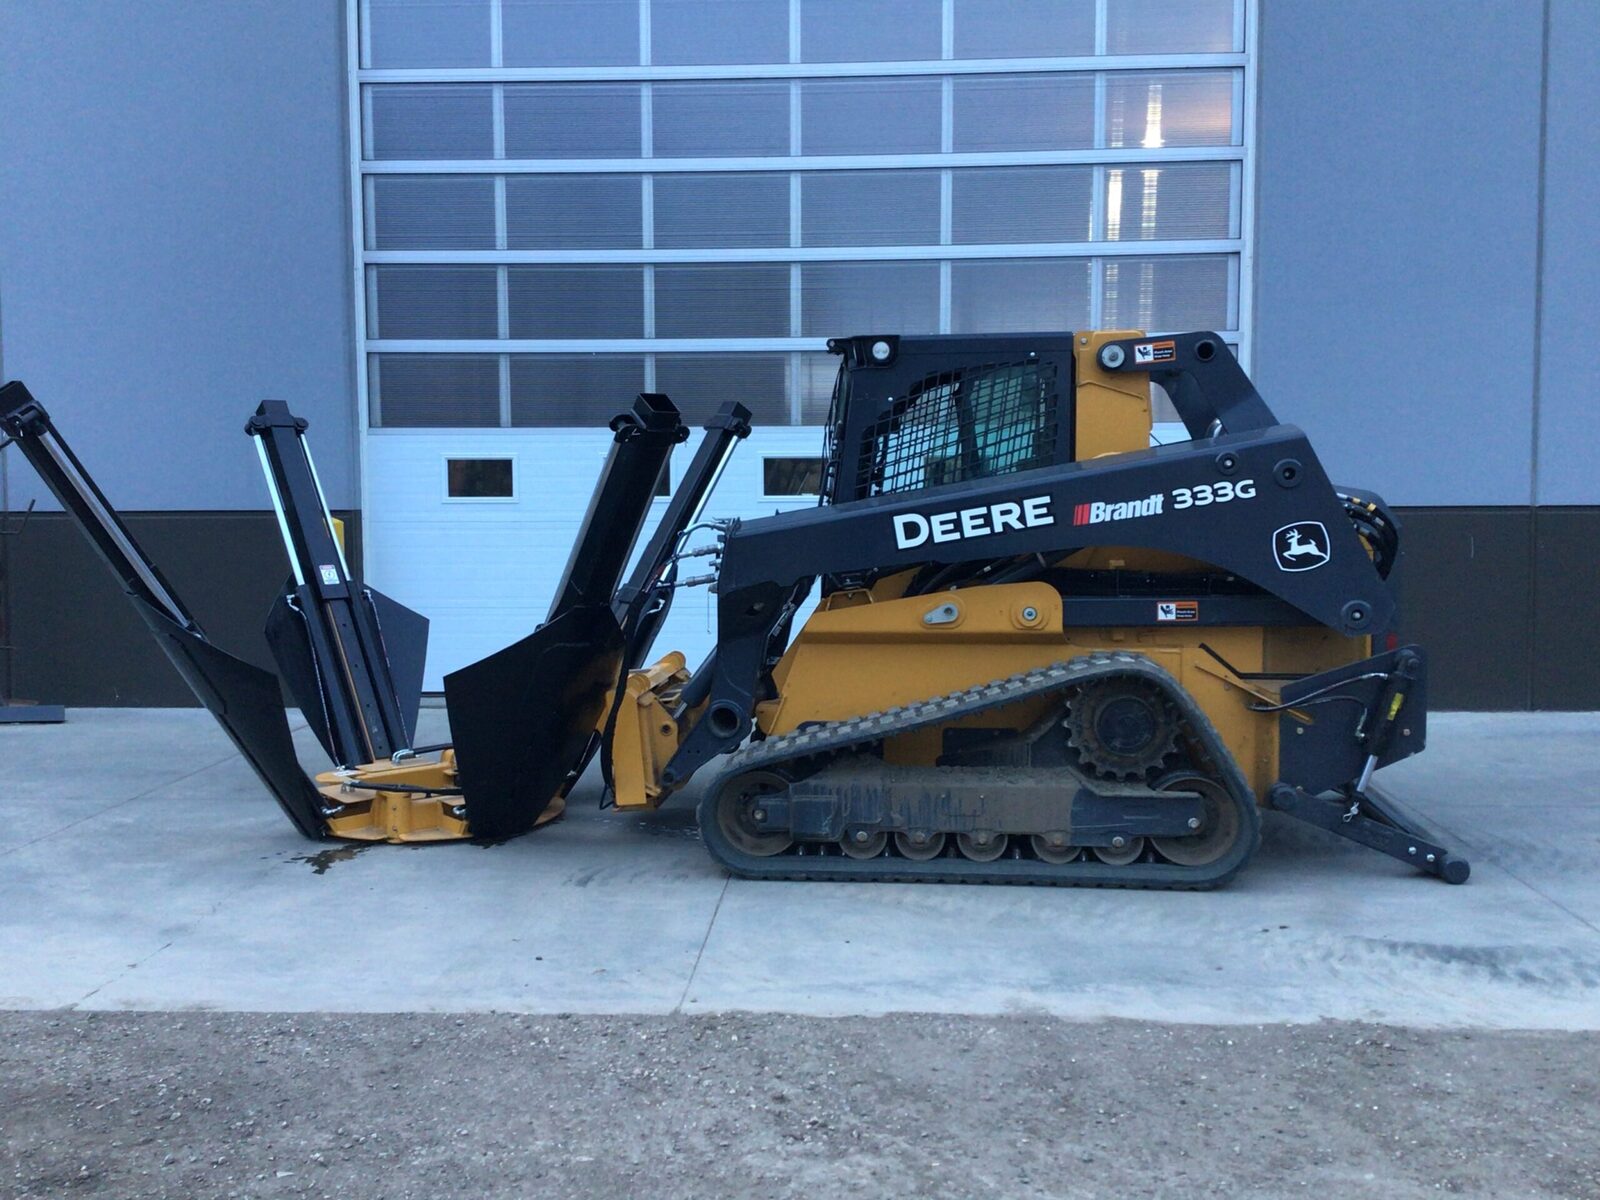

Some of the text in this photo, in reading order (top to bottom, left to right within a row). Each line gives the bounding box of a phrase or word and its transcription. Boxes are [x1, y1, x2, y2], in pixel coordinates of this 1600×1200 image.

[893, 479, 1256, 549] DEERE Brandt 333G
